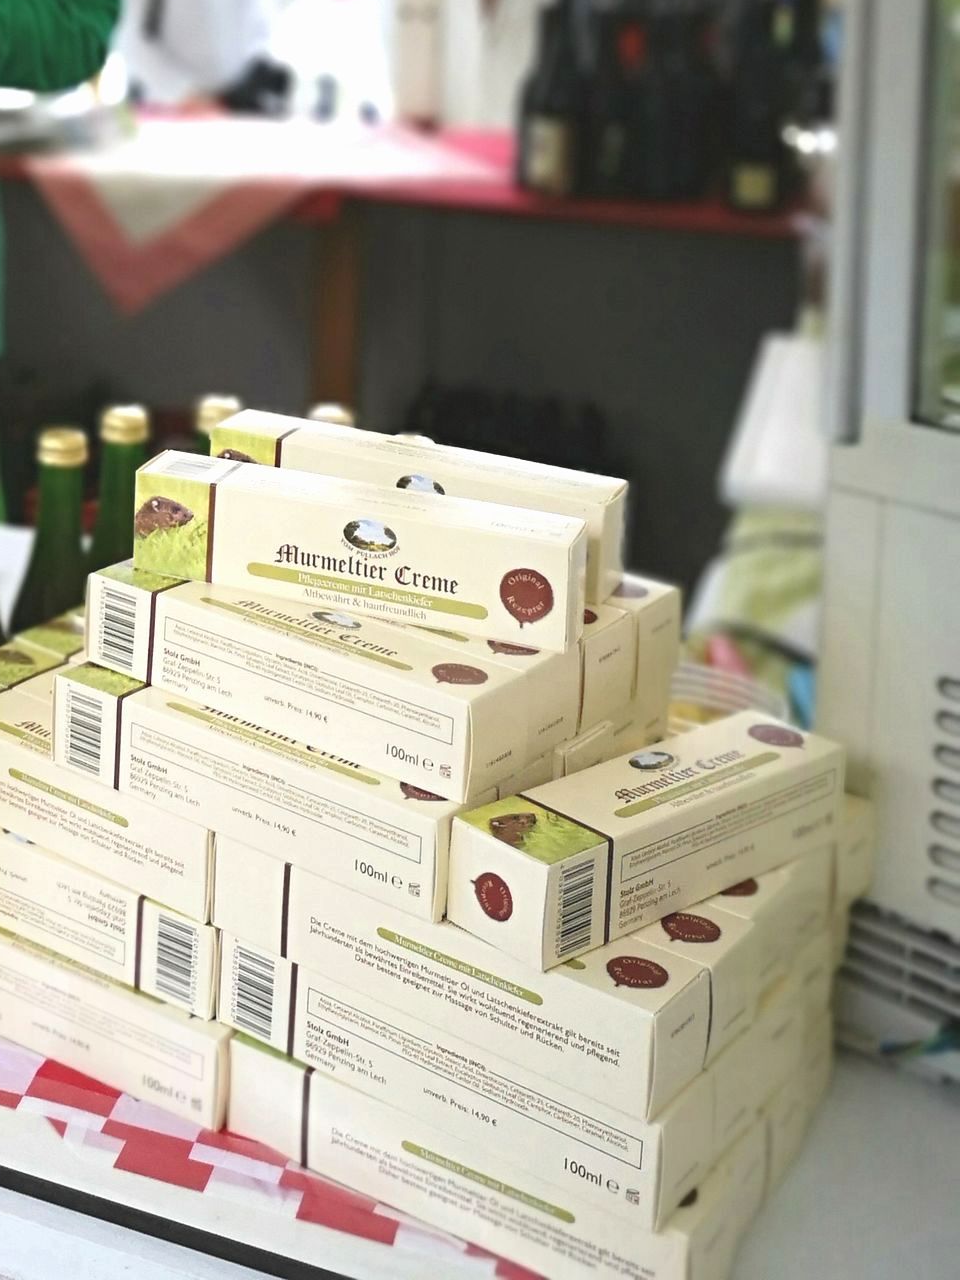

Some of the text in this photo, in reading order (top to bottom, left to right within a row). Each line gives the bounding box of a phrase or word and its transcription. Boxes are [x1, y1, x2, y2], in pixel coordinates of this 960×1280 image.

[274, 544, 459, 595] Murmeltier Creme
[507, 575, 545, 591] Original
[302, 588, 427, 620] Altbewährt & hautfreundlich
[352, 583, 367, 596] mit
[385, 742, 418, 767] 100ml
[614, 750, 745, 803] Murmeltier Creme
[354, 859, 387, 883] 100ml
[310, 915, 619, 1058] Die Creme mit dem hochwertigen Murmeltier Öl und Latschenkieferextrakt gilt bereits seit
[310, 924, 353, 952] Jahrhunderten
[355, 944, 363, 955] als
[364, 948, 397, 970] bewährtes
[447, 984, 457, 996] Sie
[458, 989, 477, 1005] wirkt
[517, 1016, 568, 1047] regenerierend
[570, 1039, 584, 1052] und
[354, 952, 564, 1053] Daher bestens geeignet zur Massage von Schulter und Rücken.
[306, 1020, 349, 1047] Stolz GmbH
[304, 1049, 335, 1071] Germany
[328, 1051, 355, 1072] Penzing
[356, 1066, 368, 1077] am
[370, 1070, 386, 1085] Lech
[368, 1059, 372, 1068] 5
[423, 1086, 496, 1127] unverb. Preis: 14,90 €
[564, 1156, 601, 1187] 100ml
